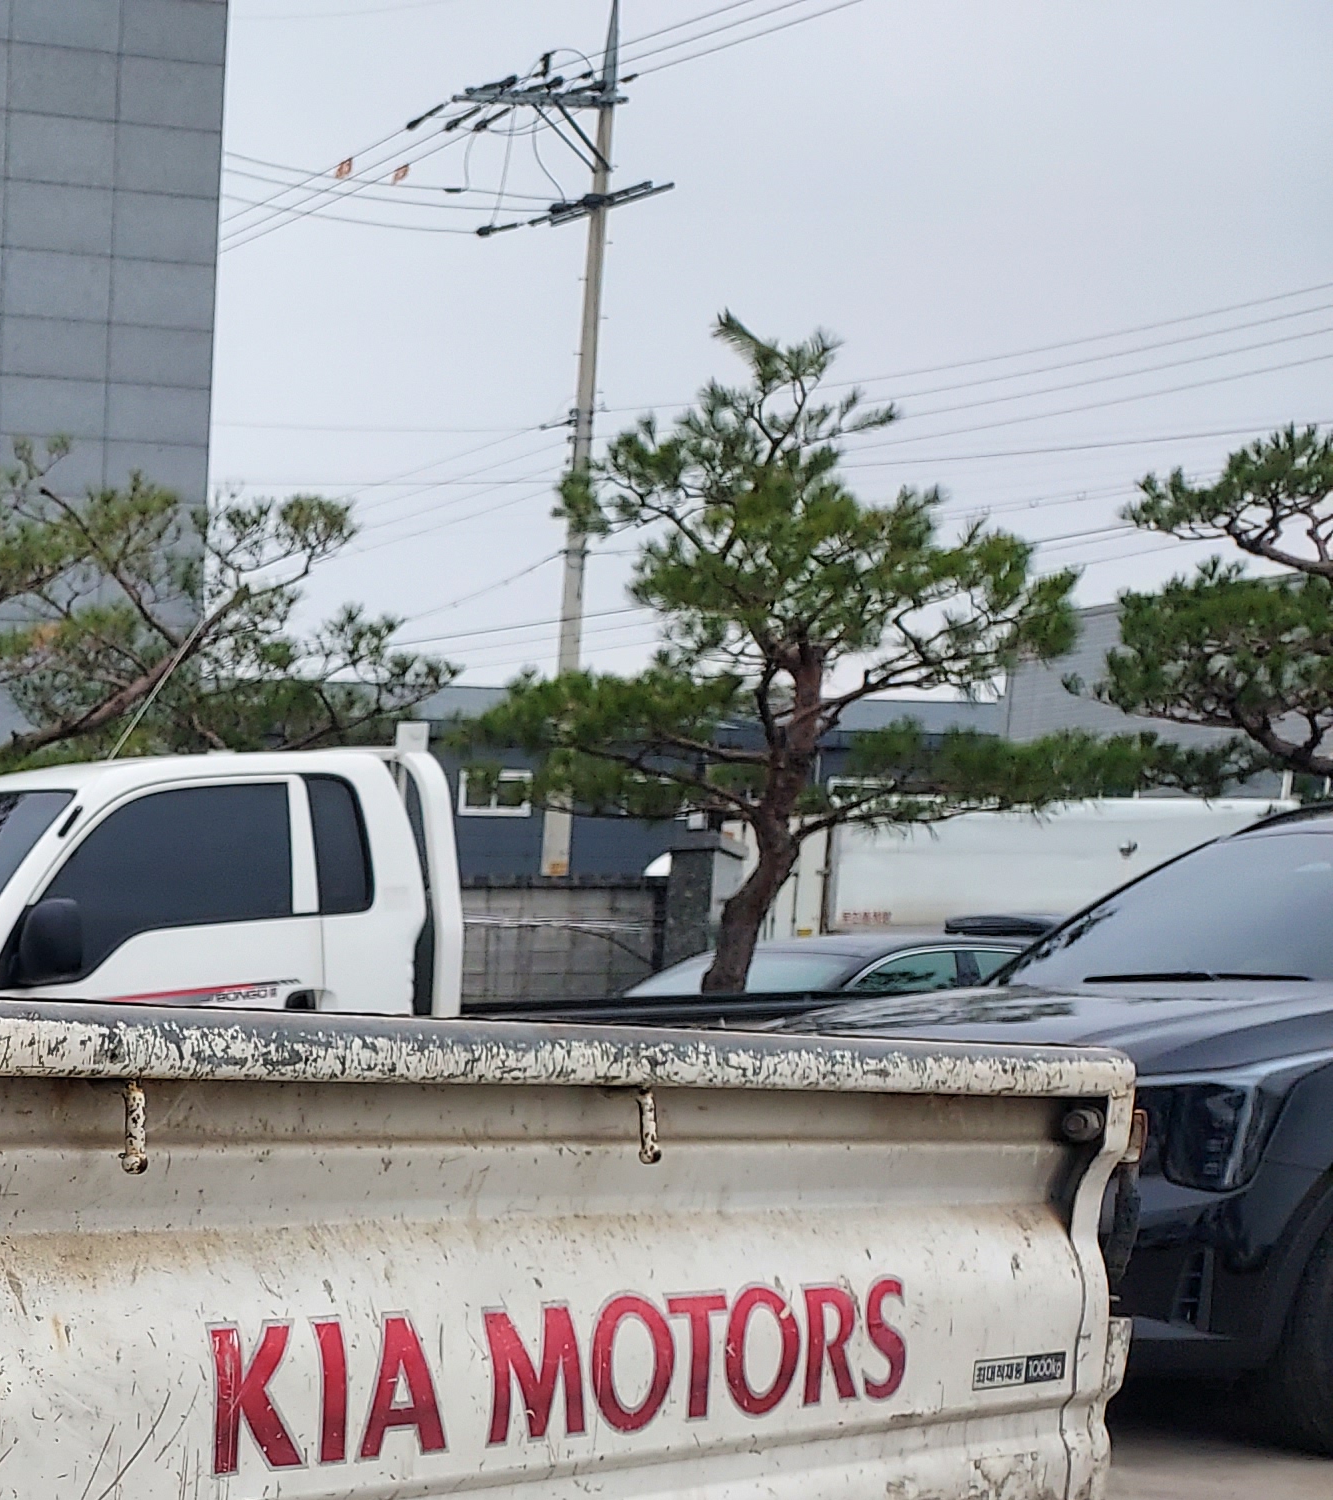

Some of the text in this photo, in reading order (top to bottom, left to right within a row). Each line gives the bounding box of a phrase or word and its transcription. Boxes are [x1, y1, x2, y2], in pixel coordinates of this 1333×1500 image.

[206, 1275, 907, 1478] KIA MOTORS
[1028, 1356, 1062, 1380] 1000kg
